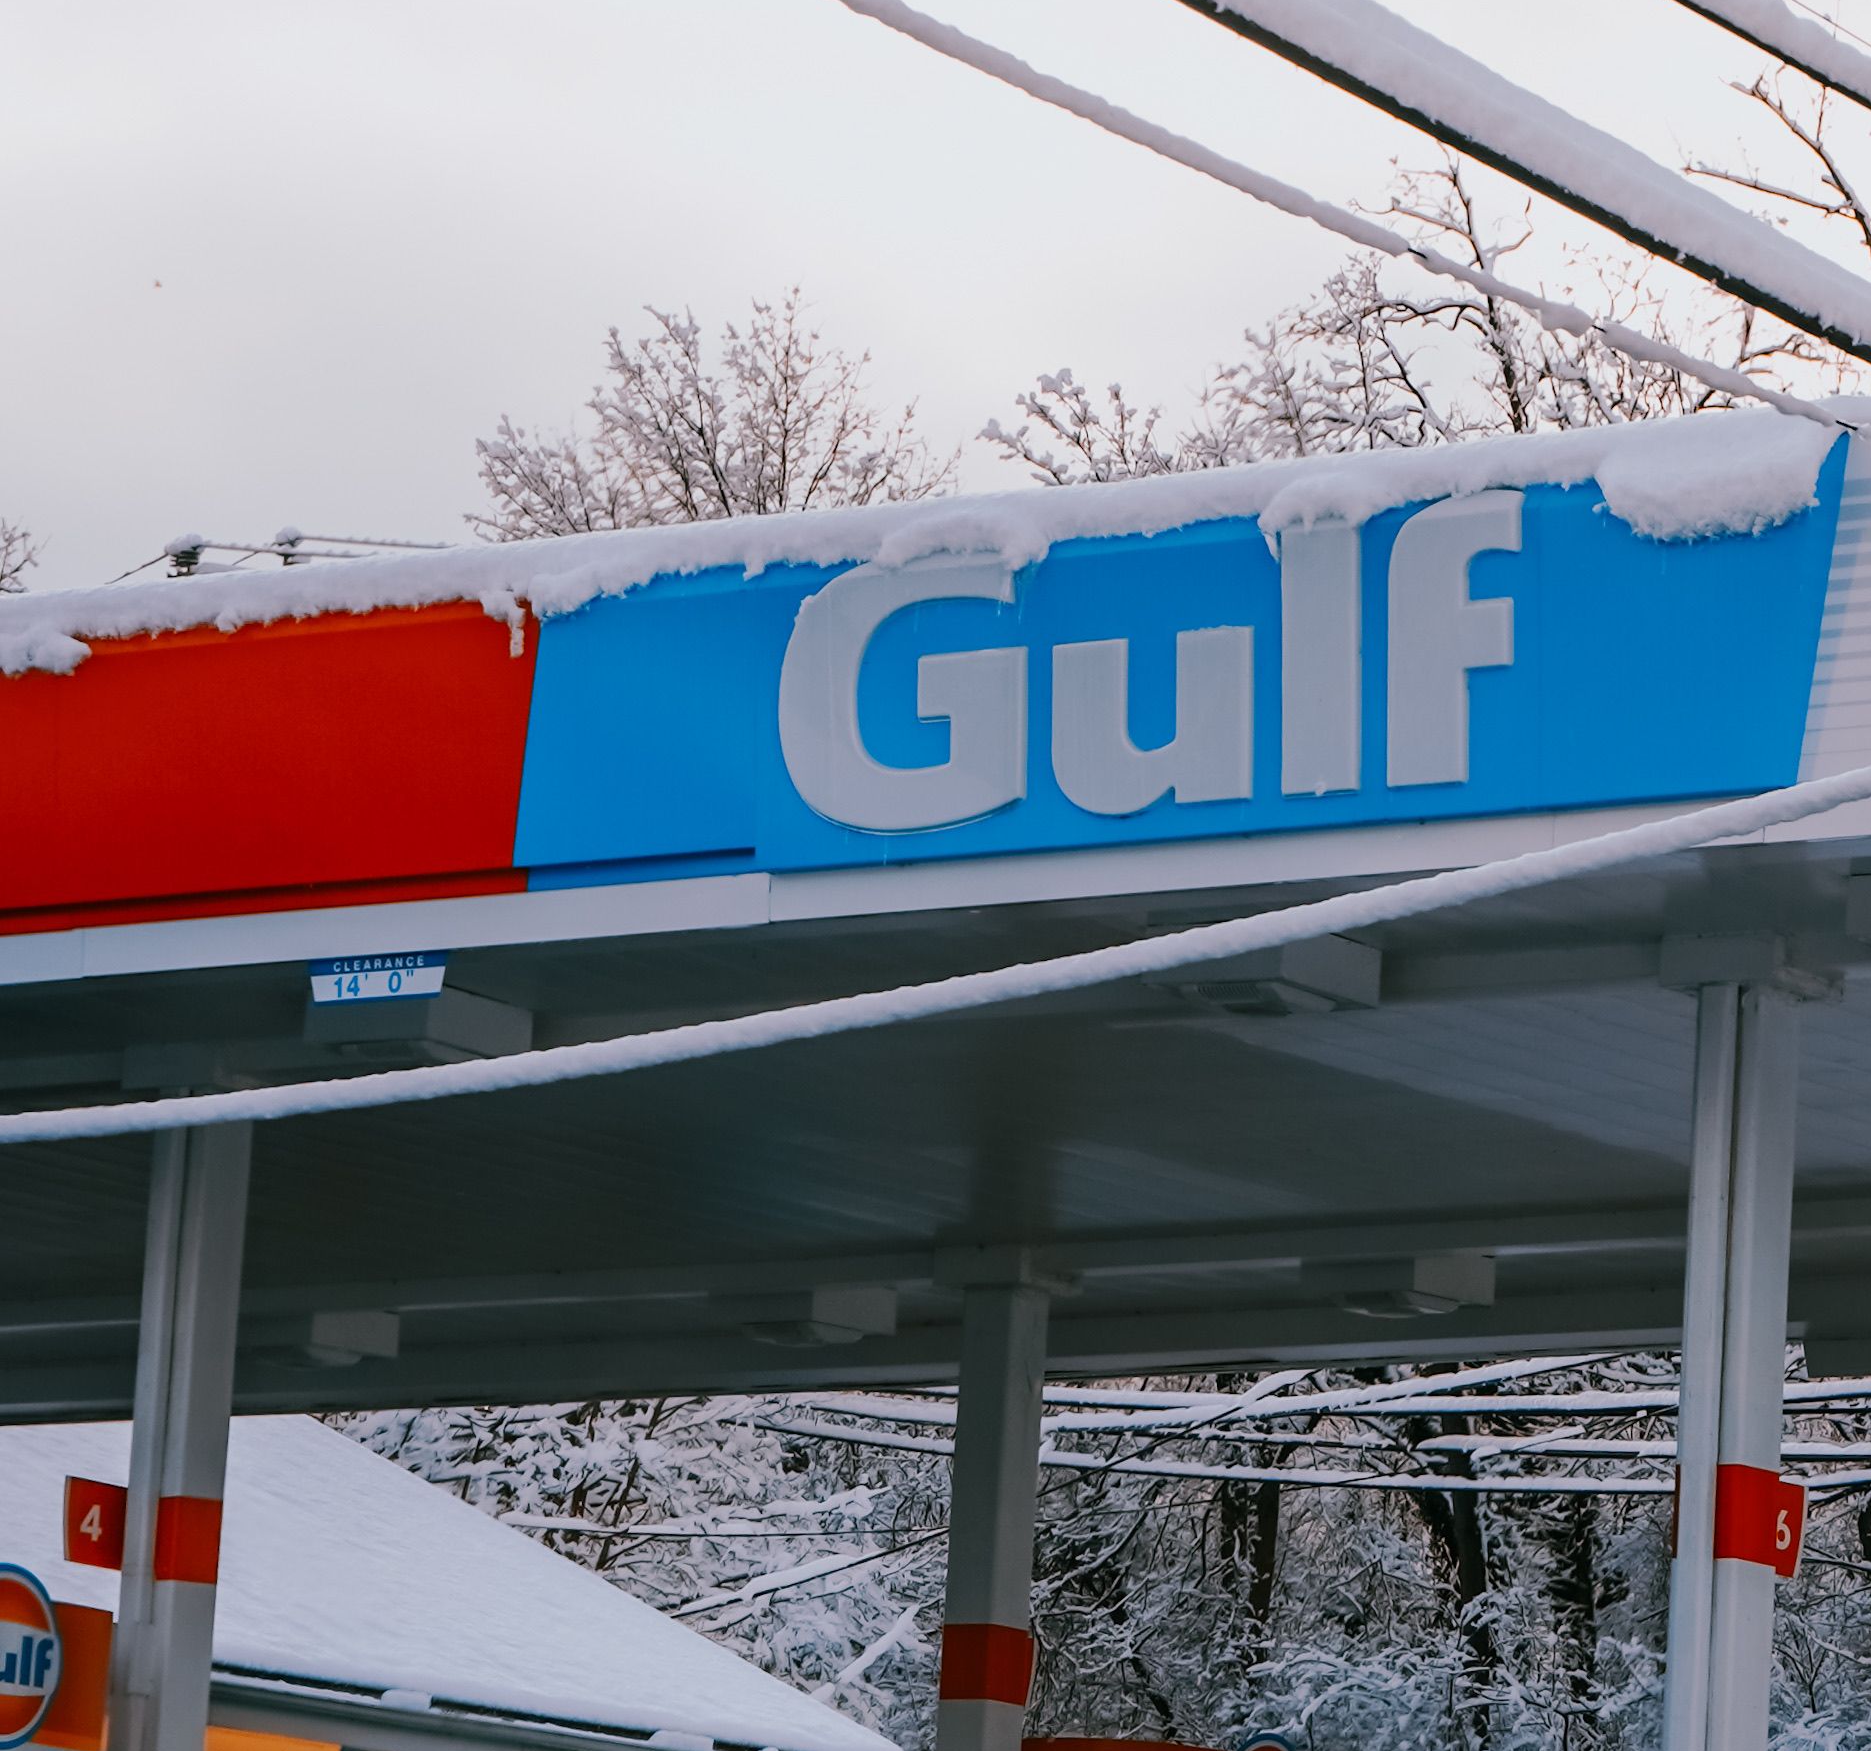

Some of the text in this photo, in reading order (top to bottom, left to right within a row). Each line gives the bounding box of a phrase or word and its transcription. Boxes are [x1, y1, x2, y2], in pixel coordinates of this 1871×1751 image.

[779, 489, 1523, 834] Gulf
[333, 955, 425, 973] CLEARANCE
[334, 969, 414, 998] 14' 0"
[80, 1504, 102, 1542] 4
[1776, 1509, 1791, 1550] 6
[0, 1636, 54, 1689] ulf
